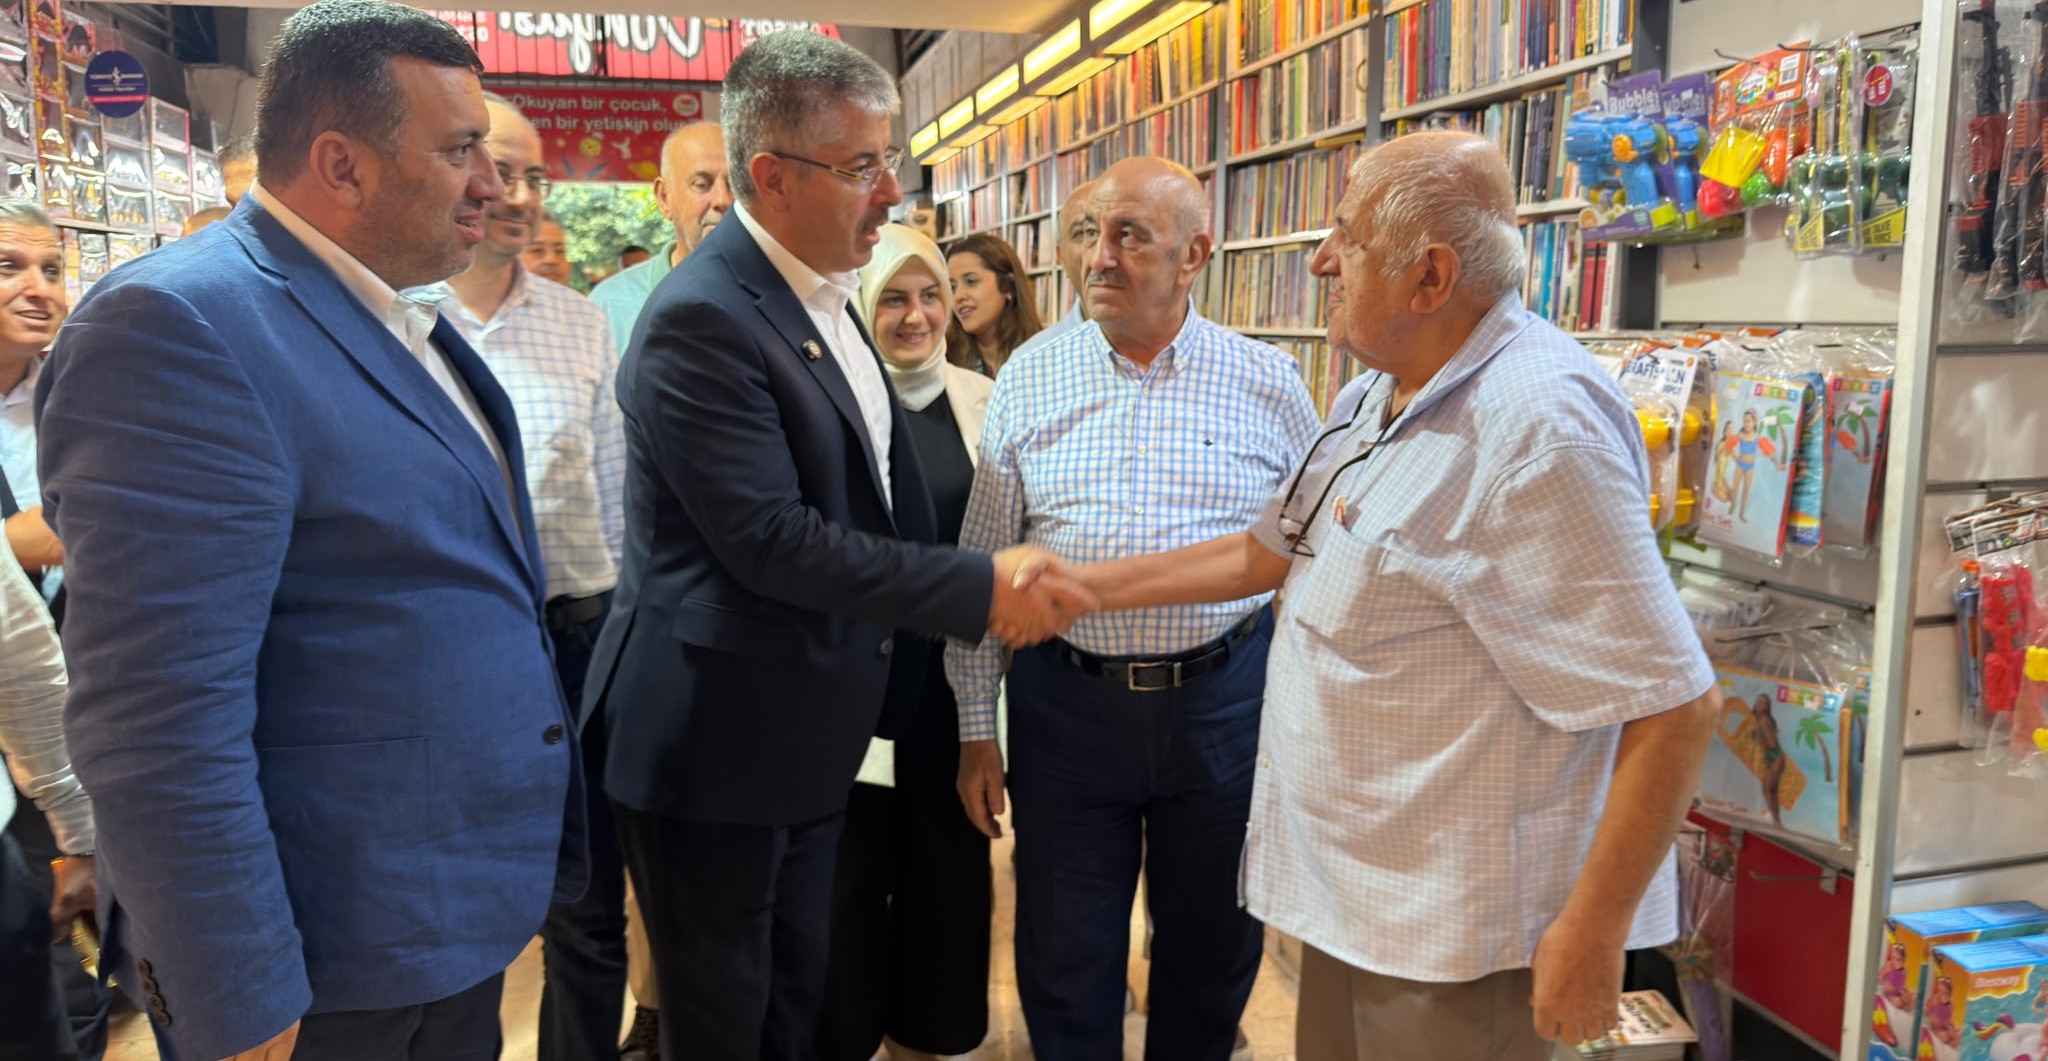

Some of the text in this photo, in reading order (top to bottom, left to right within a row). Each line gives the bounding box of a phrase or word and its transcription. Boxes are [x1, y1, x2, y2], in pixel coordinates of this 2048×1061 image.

[581, 96, 605, 110] bir
[556, 115, 579, 130] bir
[584, 116, 649, 134] yetişkin
